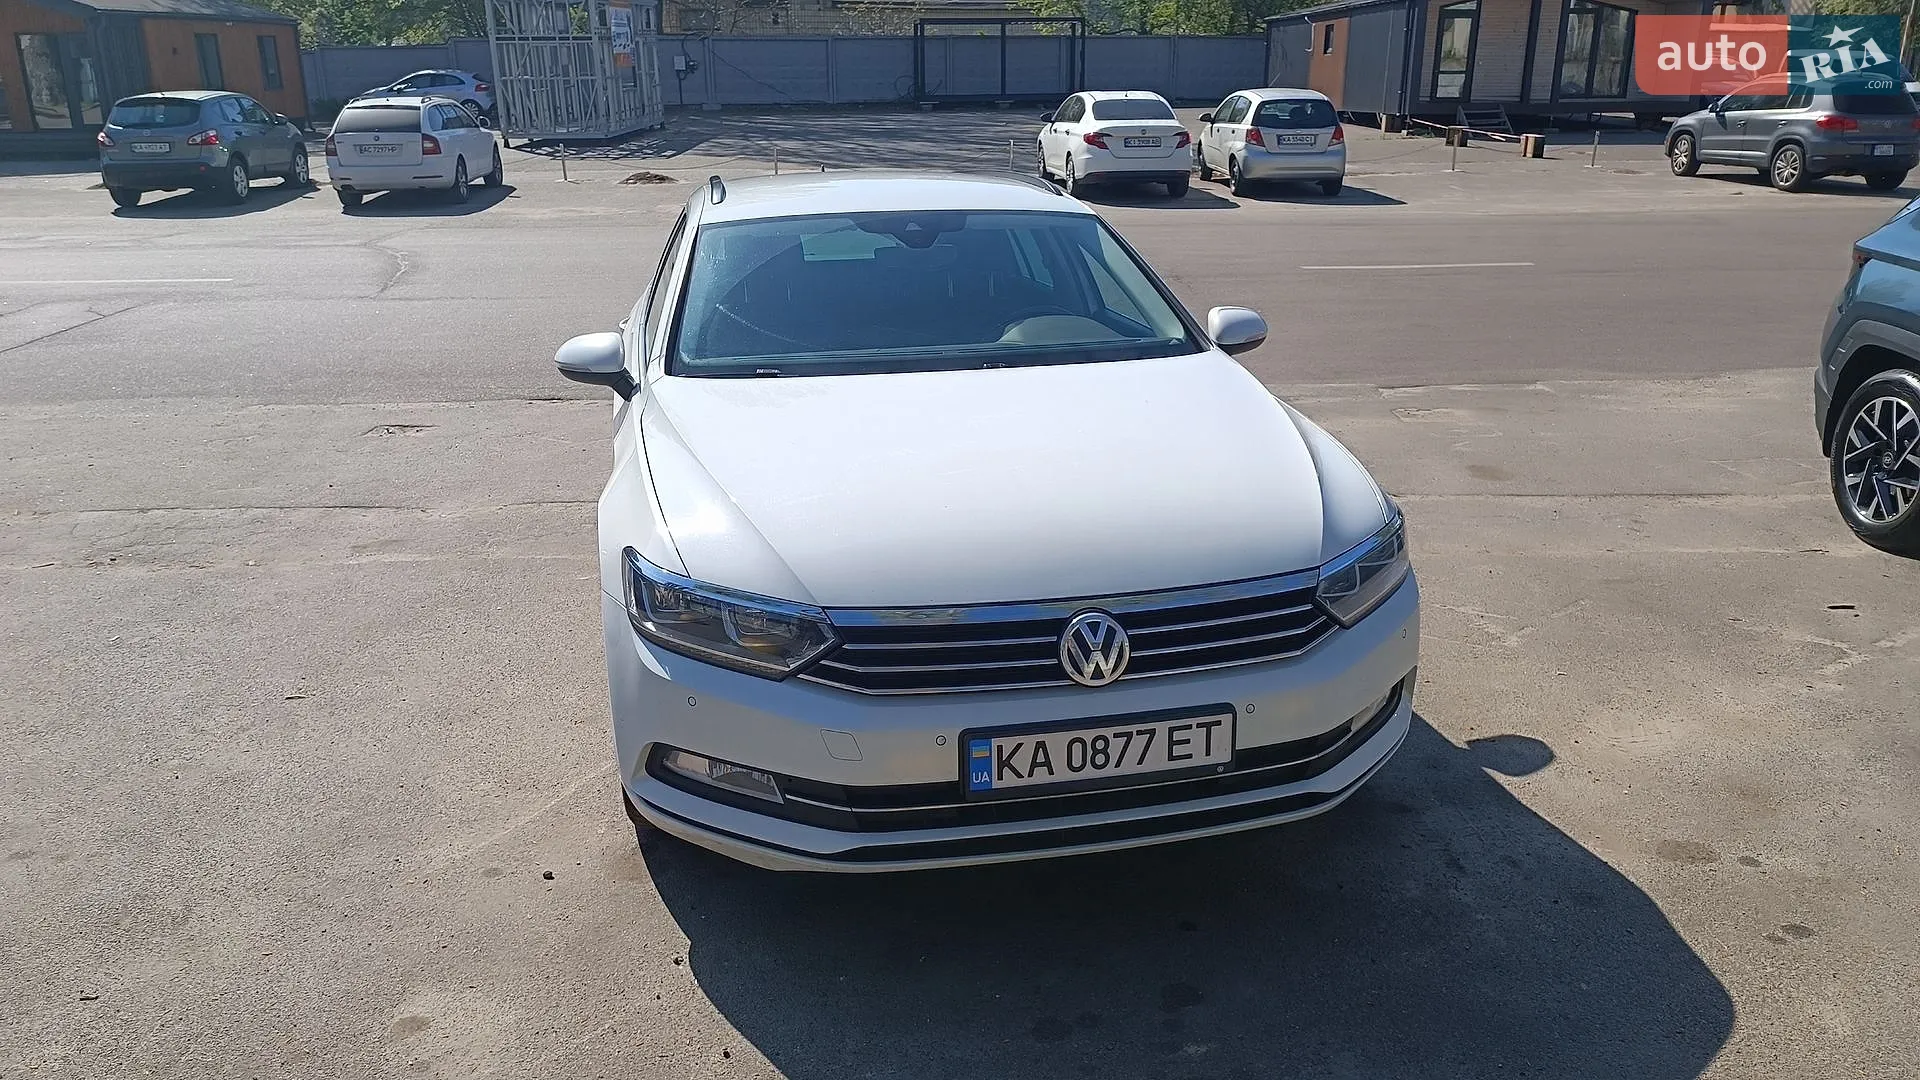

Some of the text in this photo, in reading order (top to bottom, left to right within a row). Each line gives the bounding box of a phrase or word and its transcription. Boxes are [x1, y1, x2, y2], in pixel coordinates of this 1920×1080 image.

[996, 719, 1222, 781] KA 0877 ET
[972, 771, 990, 783] UA
